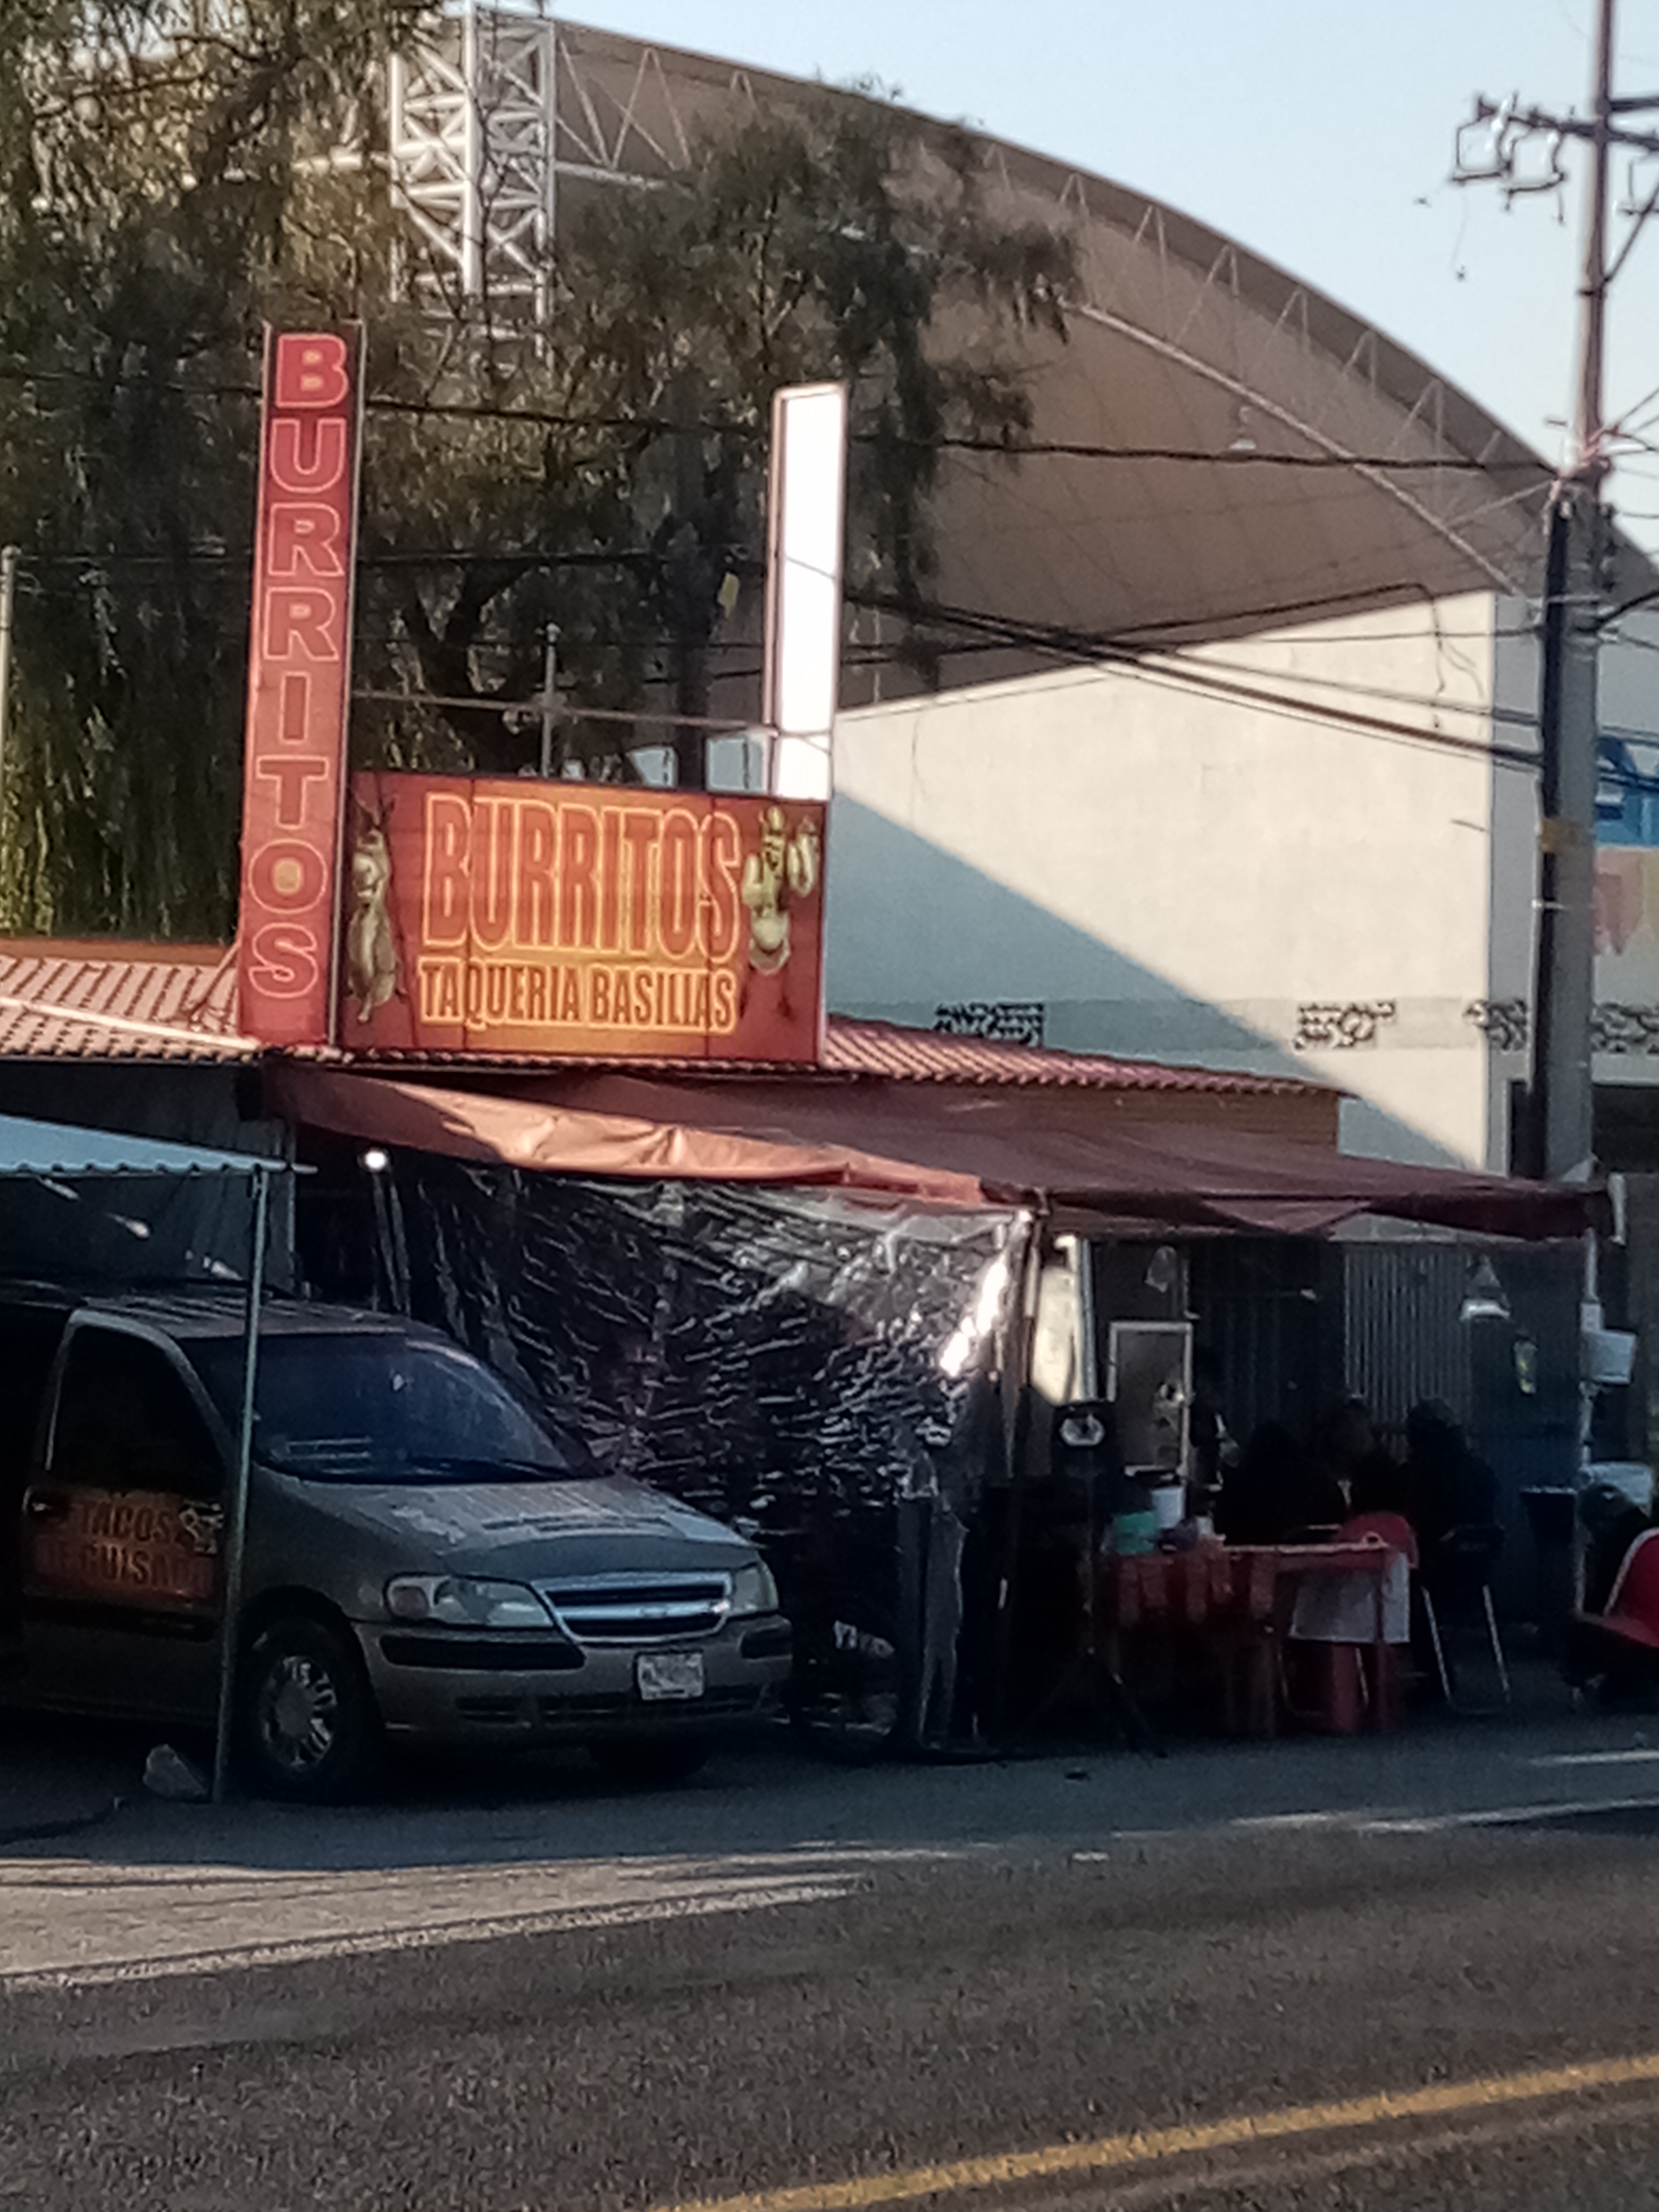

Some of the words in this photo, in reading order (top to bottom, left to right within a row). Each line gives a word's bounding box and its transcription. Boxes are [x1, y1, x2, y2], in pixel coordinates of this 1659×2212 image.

[247, 333, 349, 1001] BURRITOS
[423, 791, 743, 963] BURRITOS
[417, 957, 585, 1031] TAQUERIA
